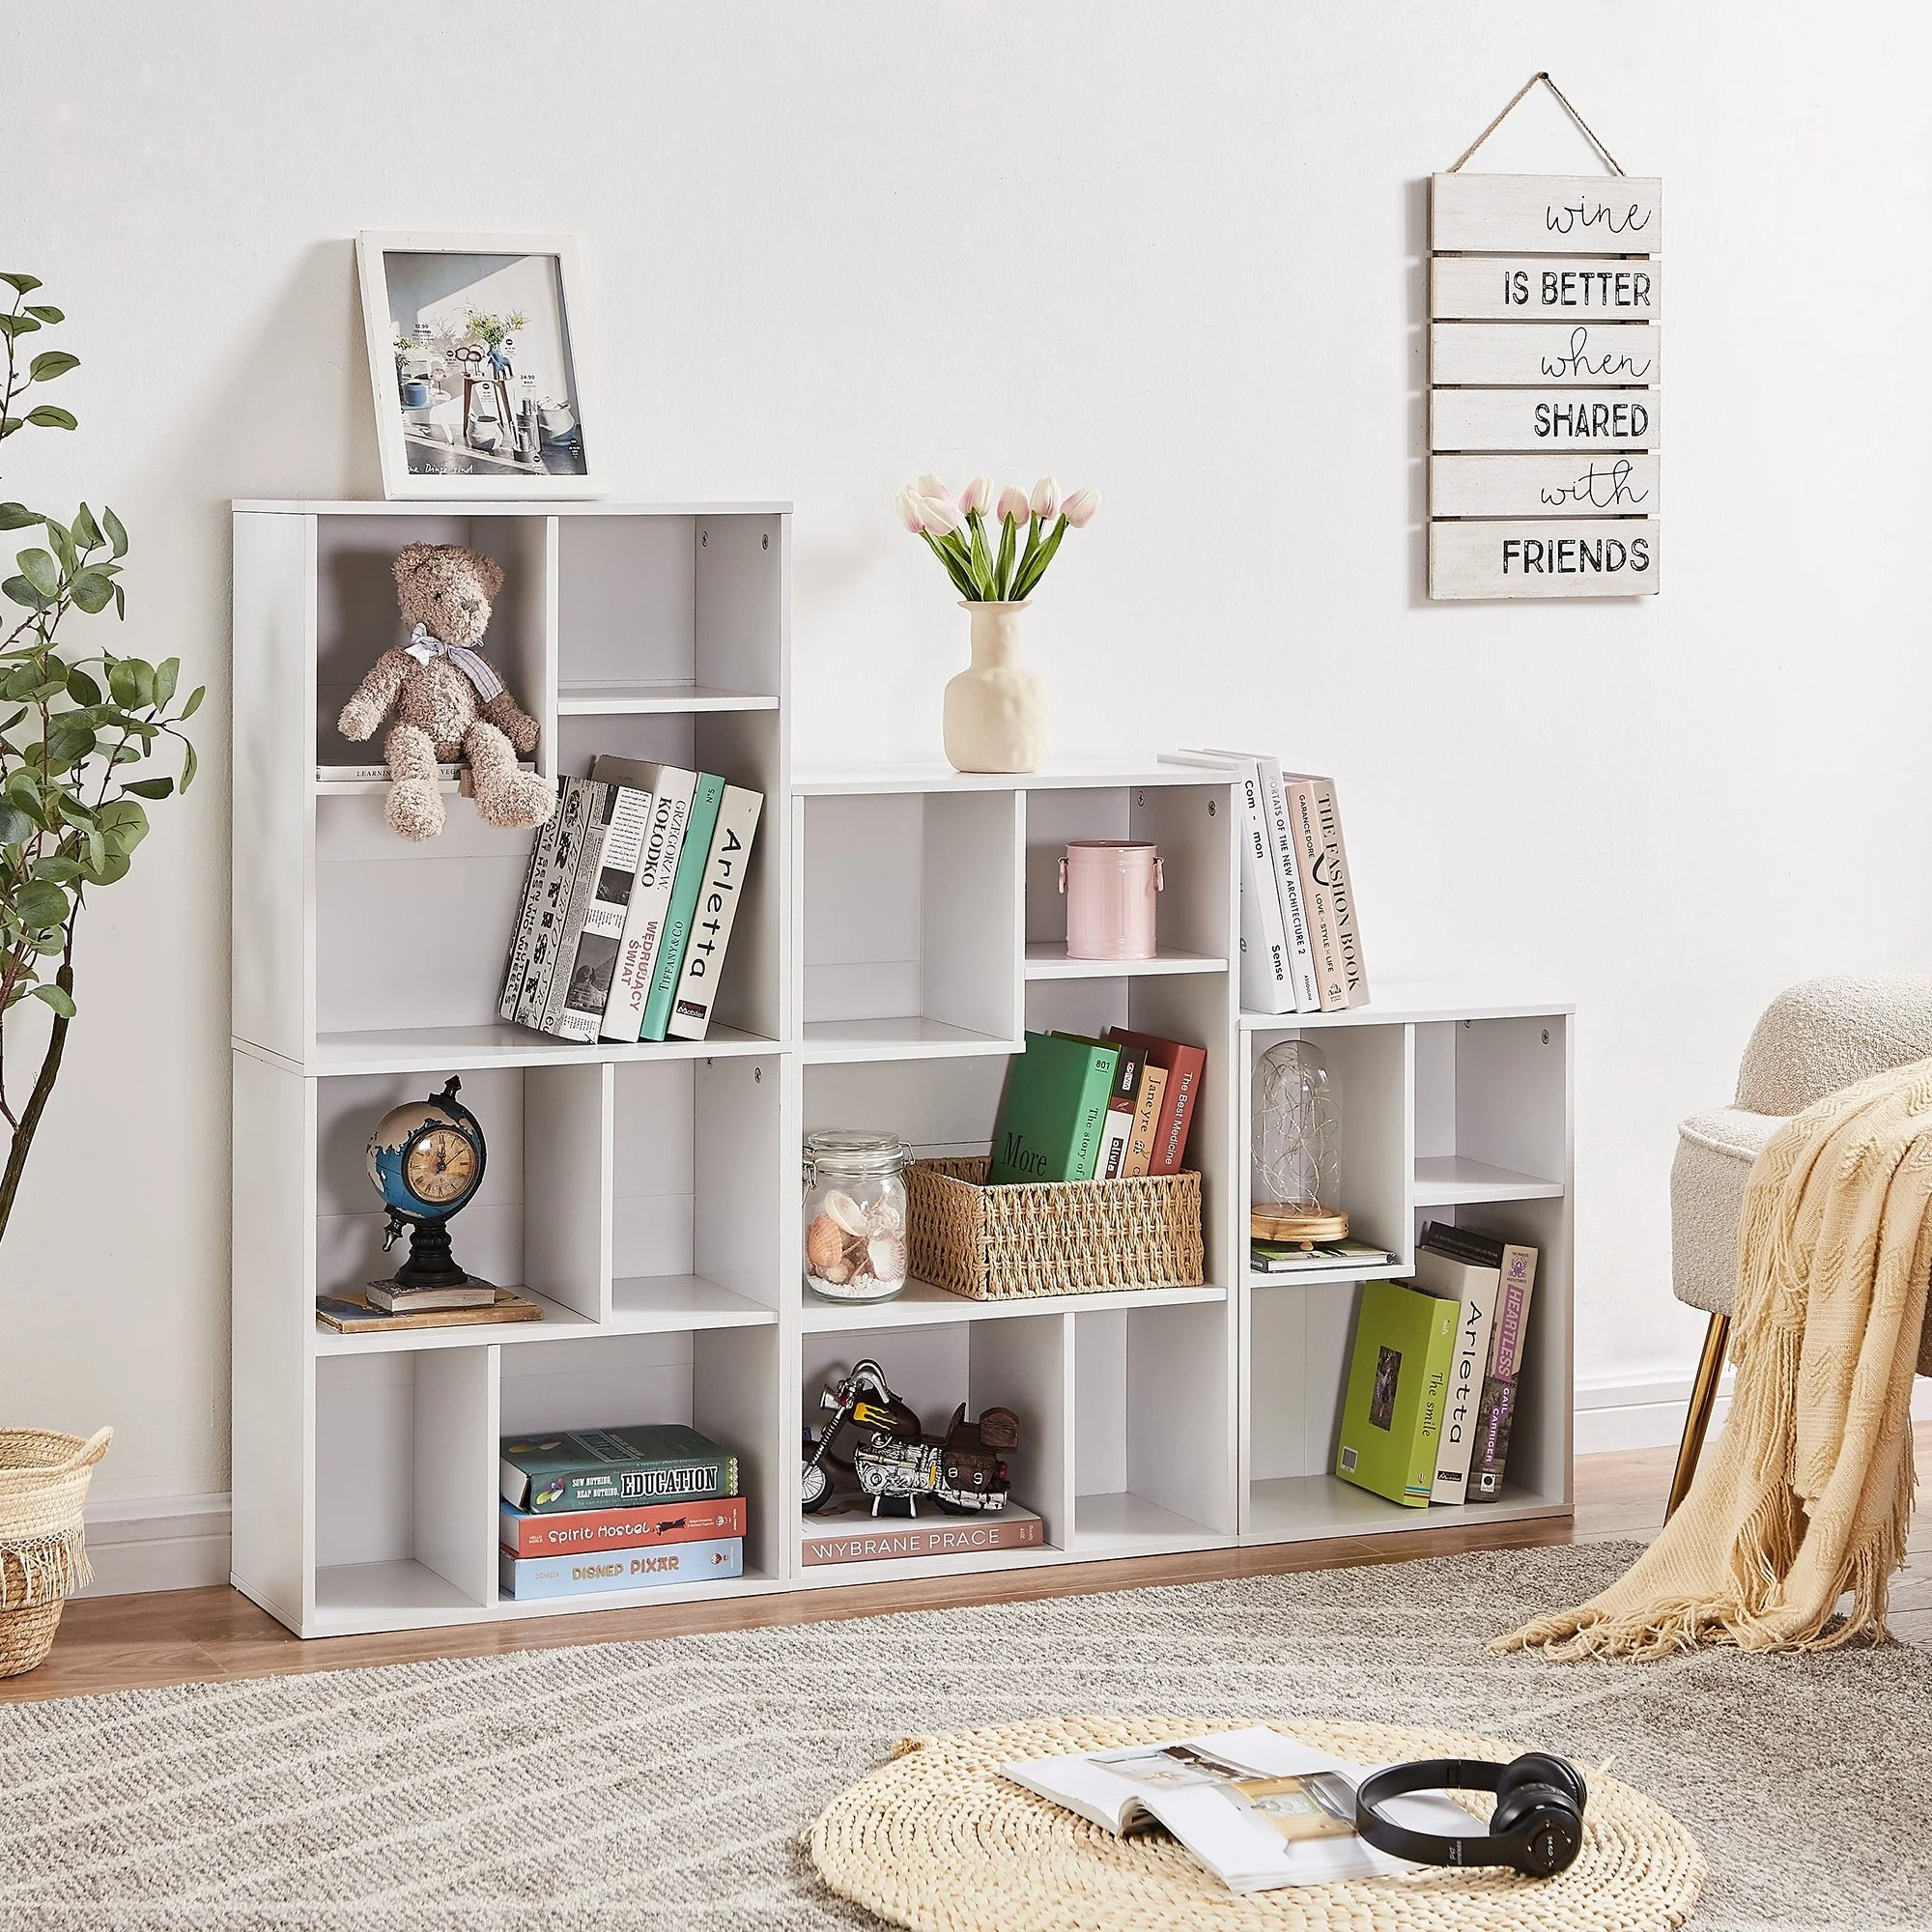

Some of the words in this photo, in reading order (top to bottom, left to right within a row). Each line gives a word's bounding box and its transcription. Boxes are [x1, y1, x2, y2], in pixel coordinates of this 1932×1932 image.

[1547, 196, 1651, 234] wine
[1505, 271, 1529, 305] IS
[1542, 272, 1651, 306] BETTER
[1541, 327, 1651, 378] when
[1534, 403, 1649, 438] SHARED
[1541, 460, 1649, 508] with
[1503, 539, 1650, 574] FRIENDS
[1245, 780, 1255, 809] Com
[1253, 831, 1264, 859] mon
[1277, 819, 1285, 831] OF
[1299, 795, 1311, 835] GARANCE
[1306, 836, 1315, 859] DORE
[1319, 794, 1335, 838] THE
[641, 796, 673, 888] KOŁODKO
[662, 800, 686, 872] GRZEGORZ
[1279, 835, 1288, 852] THE
[1282, 855, 1293, 876] NEW
[657, 876, 669, 890] W.
[1326, 843, 1350, 926] FASHION
[690, 827, 743, 978] Arletta
[1286, 880, 1305, 946] ARCHITECTURE
[1315, 893, 1324, 915] LOVE
[1321, 924, 1330, 948] STYLE
[621, 939, 642, 985] ŚWIAT
[1272, 945, 1283, 981] Sense
[1325, 956, 1334, 973] LIFE
[1341, 933, 1361, 991] BOOK
[1095, 1060, 1110, 1070] 801
[1180, 1072, 1193, 1091] The
[1145, 1076, 1162, 1108] Jane
[1175, 1094, 1188, 1117] Best
[1086, 1108, 1099, 1128] The
[1140, 1109, 1151, 1132] yre
[1001, 1131, 1047, 1176] More
[1078, 1132, 1091, 1160] story
[1165, 1120, 1183, 1165] Medicine
[1076, 1163, 1085, 1176] of
[1498, 1288, 1523, 1377] HEARTLESS
[1428, 1372, 1444, 1396] The
[1449, 1300, 1483, 1443] Arletta
[1501, 1387, 1510, 1414] GAIL
[1422, 1402, 1436, 1436] smile
[1486, 1407, 1500, 1463] CARRIGER
[572, 1477, 585, 1487] SOW
[577, 1490, 593, 1499] REAP
[620, 1466, 719, 1498] EDUCATION
[548, 1527, 594, 1544] Spirit
[598, 1521, 650, 1538] Hostel
[811, 1535, 921, 1559] WYBRANE
[929, 1528, 1000, 1550] PRACE
[630, 1556, 680, 1575] PIXAR
